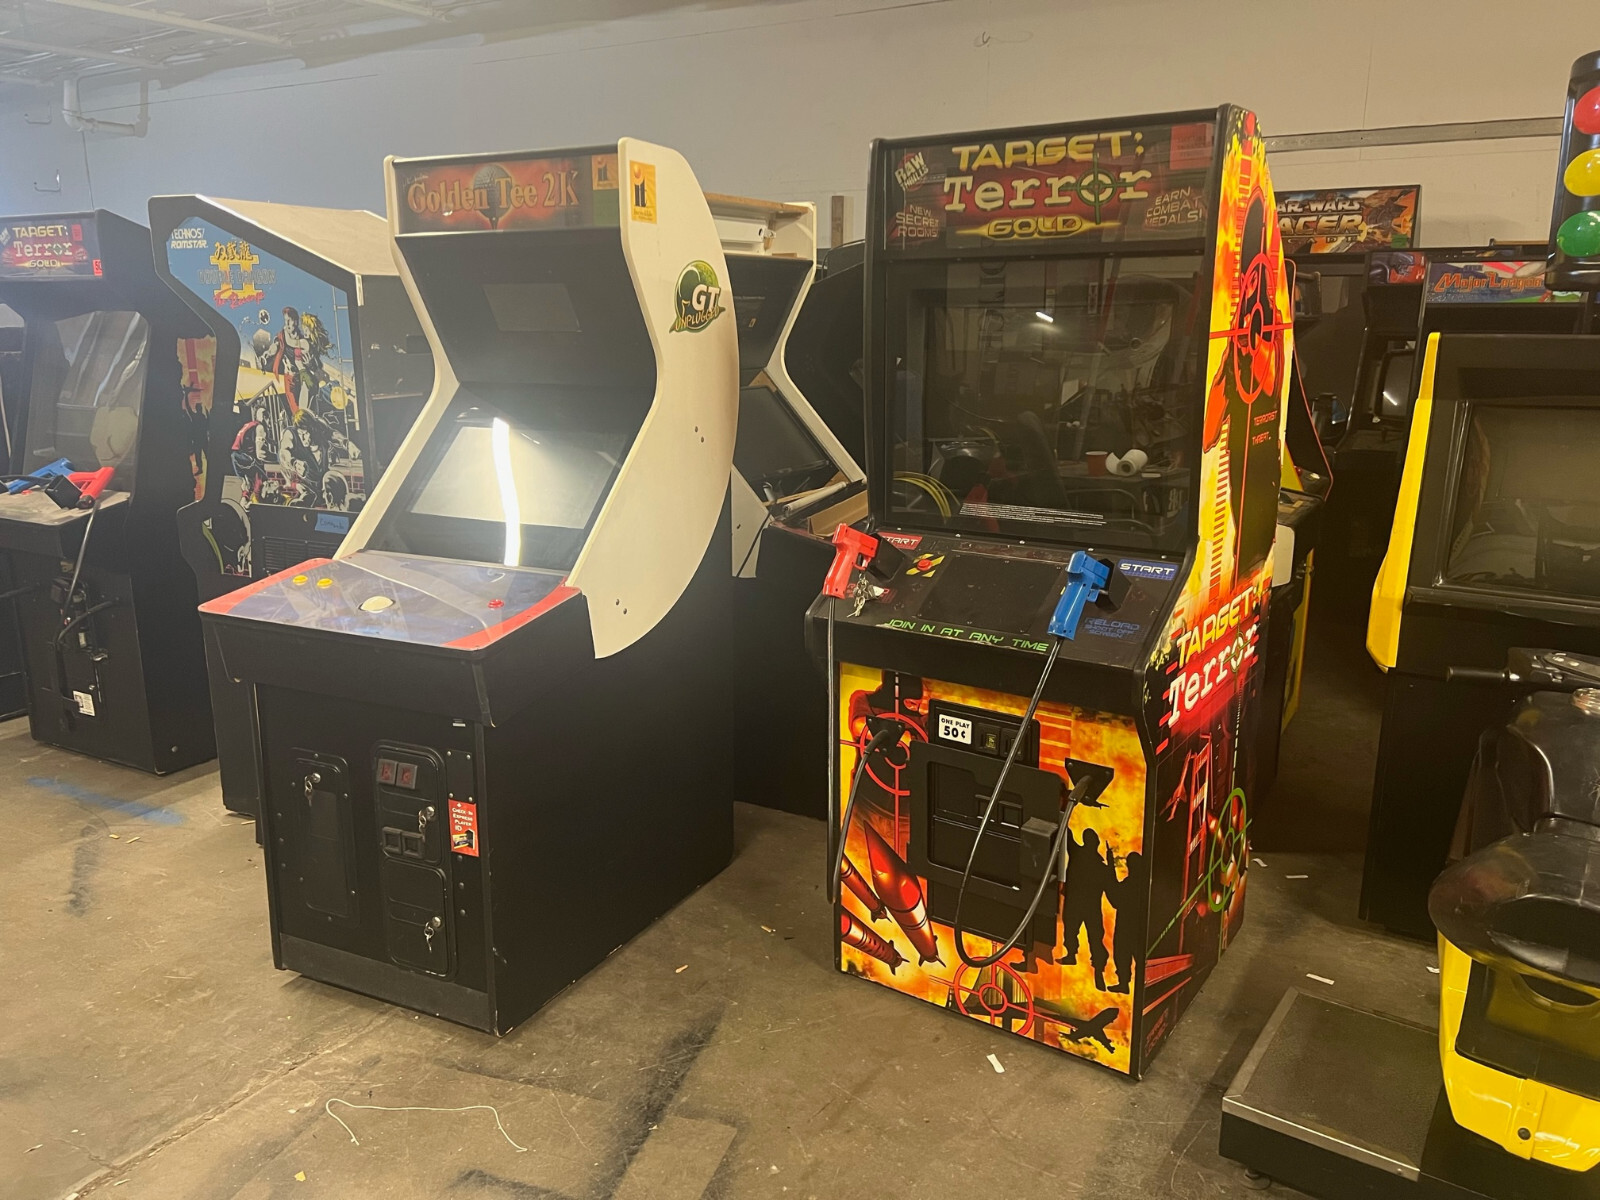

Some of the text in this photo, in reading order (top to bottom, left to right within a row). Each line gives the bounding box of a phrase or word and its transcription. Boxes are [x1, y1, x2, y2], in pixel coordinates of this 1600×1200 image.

[952, 131, 1144, 171] TARGET:
[895, 152, 925, 184] RAW
[407, 170, 579, 213] Golden Tee 2K
[944, 169, 1152, 212] Terror
[1155, 186, 1191, 206] EARN
[909, 204, 932, 217] NEW
[1146, 196, 1201, 218] COMBAT
[1277, 201, 1303, 213] AR
[896, 211, 939, 228] SECRET
[988, 214, 1082, 238] GOLD
[1279, 214, 1363, 235] ACER
[12, 224, 69, 239] TARGET:
[13, 240, 73, 257] Terror
[29, 259, 58, 268] GOLD
[691, 284, 720, 313] GT
[882, 536, 918, 545] TART
[1120, 563, 1175, 575] START
[1084, 617, 1140, 630] RELOAD
[1176, 586, 1262, 669] TARGET:
[884, 618, 1050, 652] JOIN IN AT ANY TIME
[1167, 623, 1258, 728] Terror
[941, 718, 970, 729] ONE PLAY
